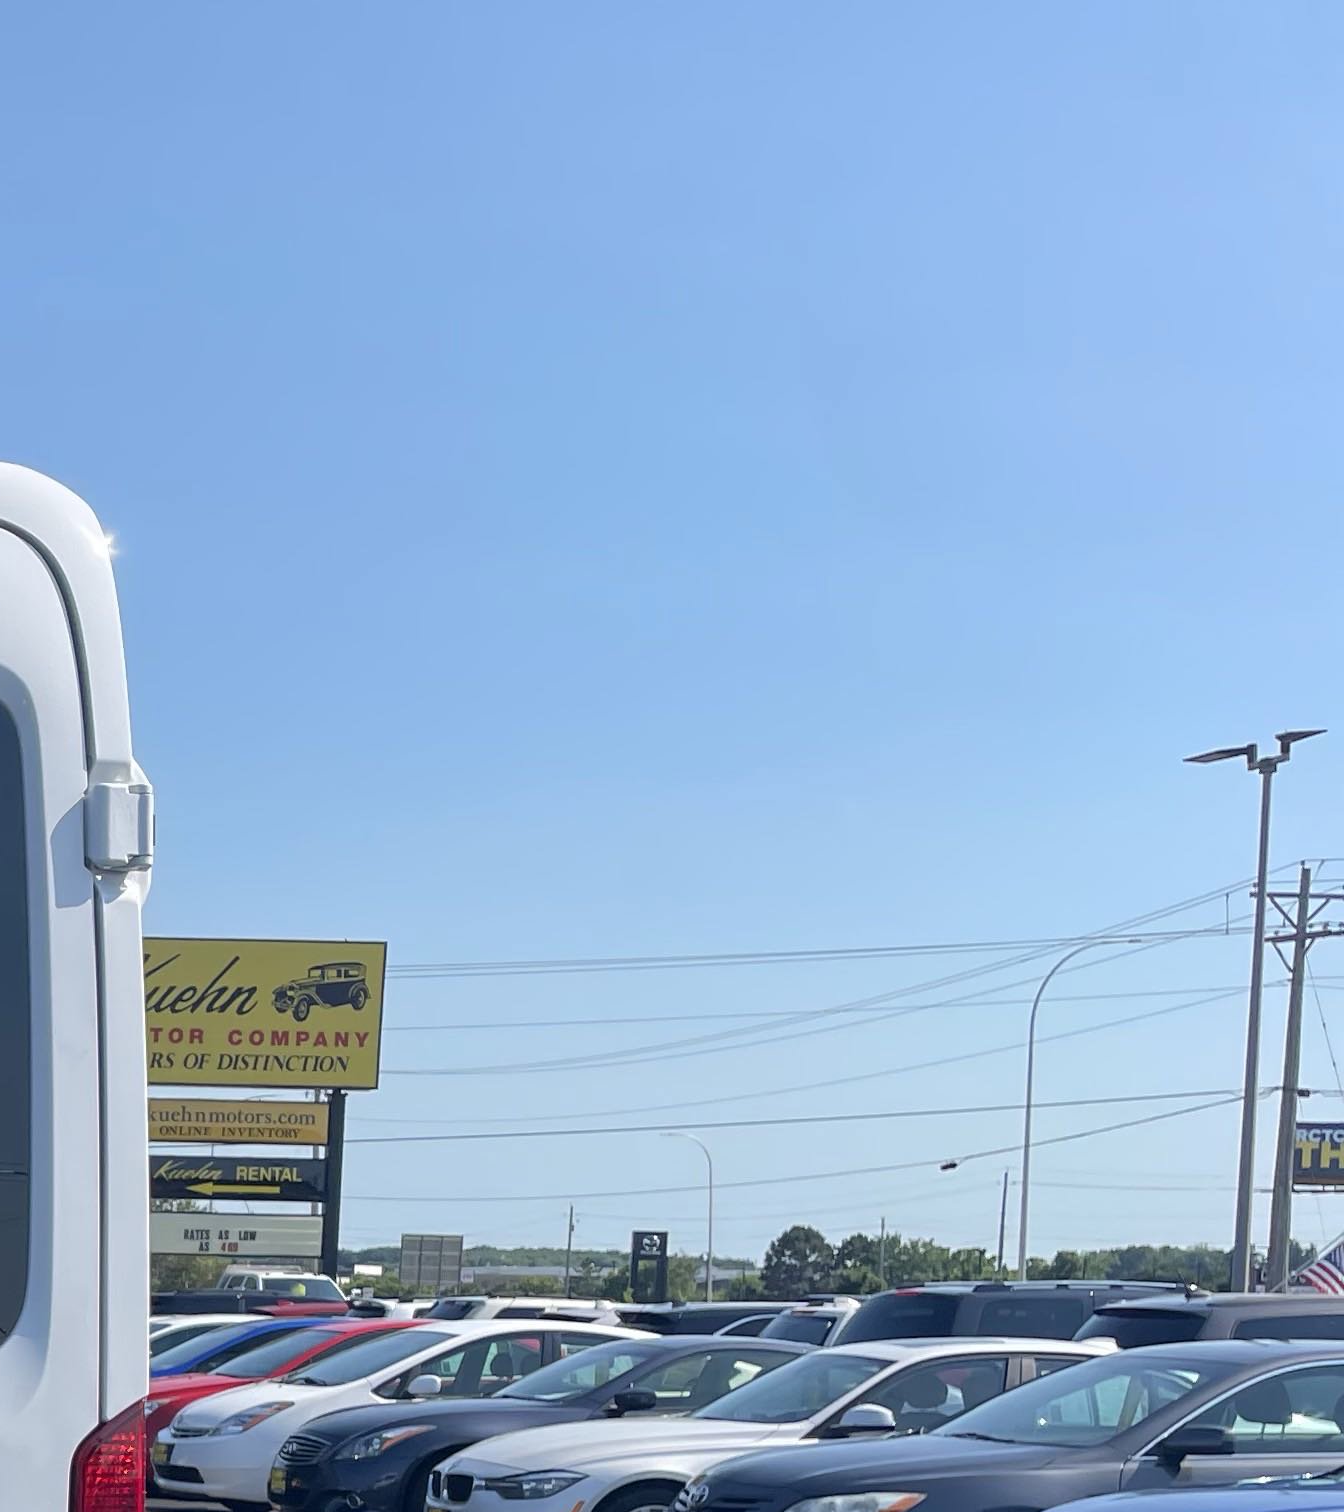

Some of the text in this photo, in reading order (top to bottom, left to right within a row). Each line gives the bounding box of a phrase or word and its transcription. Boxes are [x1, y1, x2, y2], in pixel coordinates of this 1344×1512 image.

[150, 1027, 370, 1048] TOR COMPANY
[183, 1052, 211, 1070] OF
[217, 1053, 350, 1072] DISTINCTION
[159, 1125, 301, 1139] ONLINE INVENTORY
[153, 1160, 303, 1182] Kuehn RENTAL
[184, 1229, 257, 1241] RATES AS LOW
[199, 1242, 210, 1252] AS
